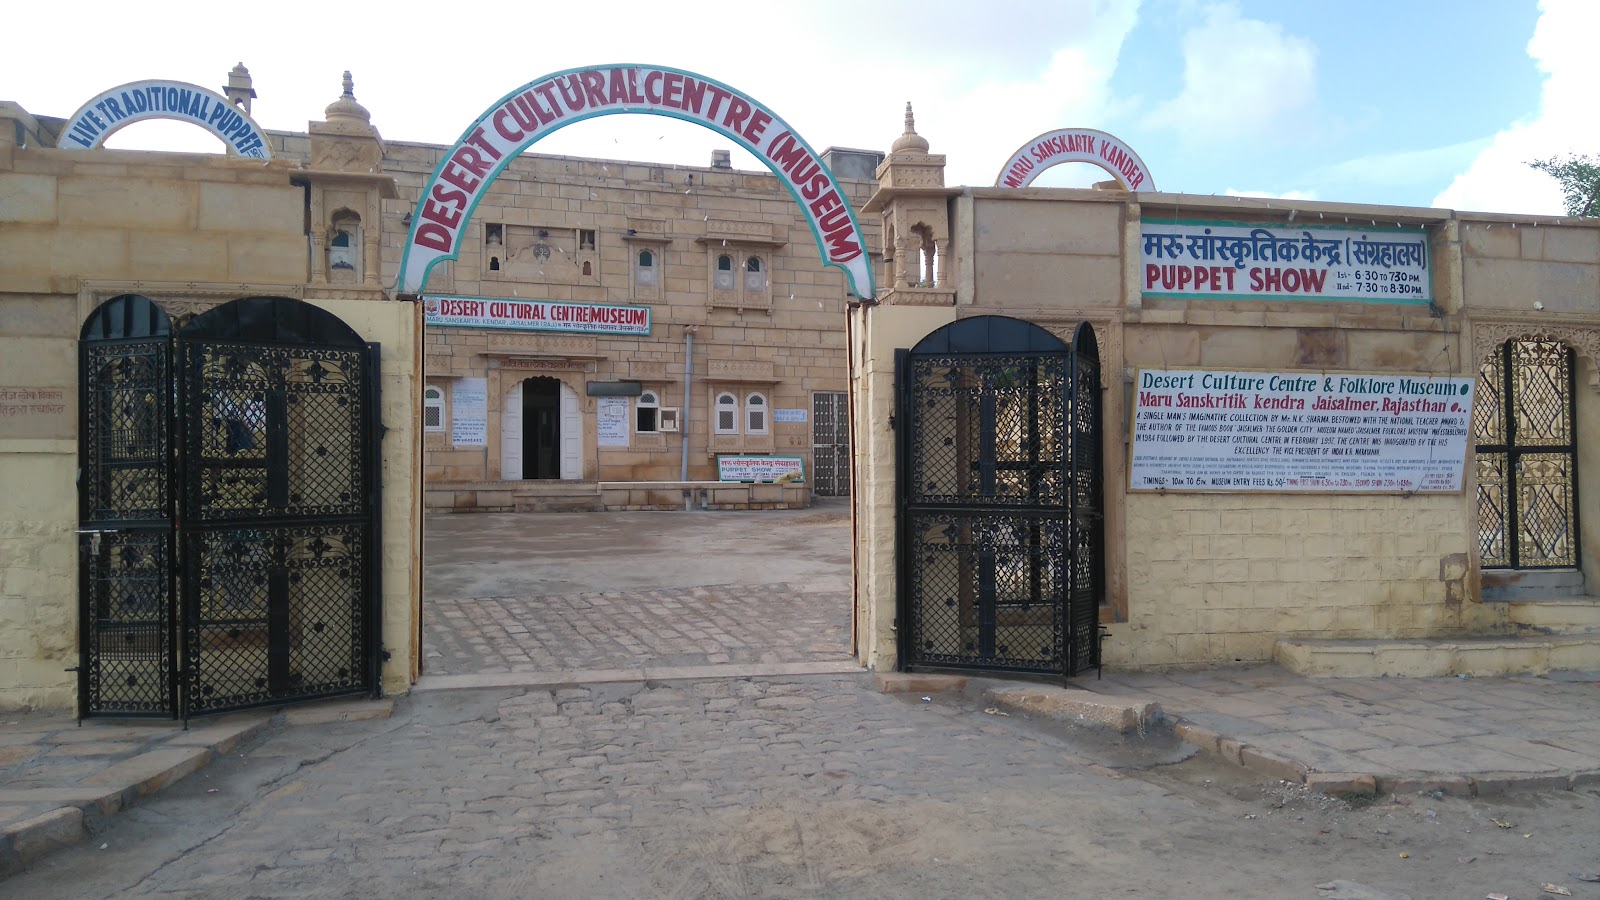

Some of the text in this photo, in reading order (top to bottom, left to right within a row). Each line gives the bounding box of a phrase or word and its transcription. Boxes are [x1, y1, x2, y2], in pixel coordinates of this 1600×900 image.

[68, 86, 264, 154] LIVE TRADITIONAL PUPPET
[1003, 154, 1035, 189] MARU
[1100, 139, 1144, 191] KANDER
[414, 126, 503, 254] DESERT
[767, 130, 863, 264] (MUSEUM)
[1142, 232, 1184, 259] मरु
[1145, 264, 1328, 293] PUPPET SHOW
[1380, 273, 1387, 281] TO
[1380, 285, 1388, 293] TO
[441, 300, 485, 317] DESERT
[489, 302, 546, 320] CULTURAL
[550, 305, 588, 323] CENTRE
[509, 320, 539, 328] JAISALMER
[1143, 372, 1457, 396] Desert Culture Centre & Folklore Museum
[1139, 391, 1172, 408] Maru
[1176, 392, 1248, 409] Sanskritik
[1253, 394, 1304, 410] kendra
[1381, 397, 1447, 416] Rajasthan
[1143, 411, 1164, 420] SINGLE
[1167, 412, 1187, 421] MAN'S
[1189, 412, 1227, 422] IMAGINATIVE
[1230, 413, 1268, 422] COLLECTION
[1271, 414, 1279, 422] BY
[1332, 416, 1362, 424] BESTOWED
[1363, 416, 1376, 424] WITH
[1378, 416, 1387, 424] THE
[1390, 417, 1414, 425] NATIONAL
[1416, 417, 1439, 425] TEACHER
[1136, 422, 1147, 431] THE
[1148, 423, 1173, 431] AUTHOR
[1175, 423, 1182, 432] OF
[1198, 424, 1217, 432] FAMOUS
[1266, 425, 1275, 433] THE
[1277, 425, 1297, 433] GOLDEN
[1157, 434, 1185, 442] FOLLOWED
[1187, 434, 1195, 443] BY
[1197, 435, 1208, 443] THE
[1209, 435, 1231, 443] DESERT
[1232, 435, 1258, 444] CULTURAL
[1261, 436, 1282, 444] CENTRE
[1291, 436, 1319, 444] FEBRUARY
[1349, 437, 1370, 445] CENTRE
[1234, 446, 1270, 455] EXCELLENCY
[1272, 446, 1282, 455] THE
[1295, 447, 1321, 456] PRESIDENT
[1322, 447, 1329, 456] OF
[1186, 477, 1194, 485] TO
[1211, 477, 1231, 486] MUSEUM
[1233, 478, 1250, 486] ENTRY
[1252, 478, 1266, 486] FEES
